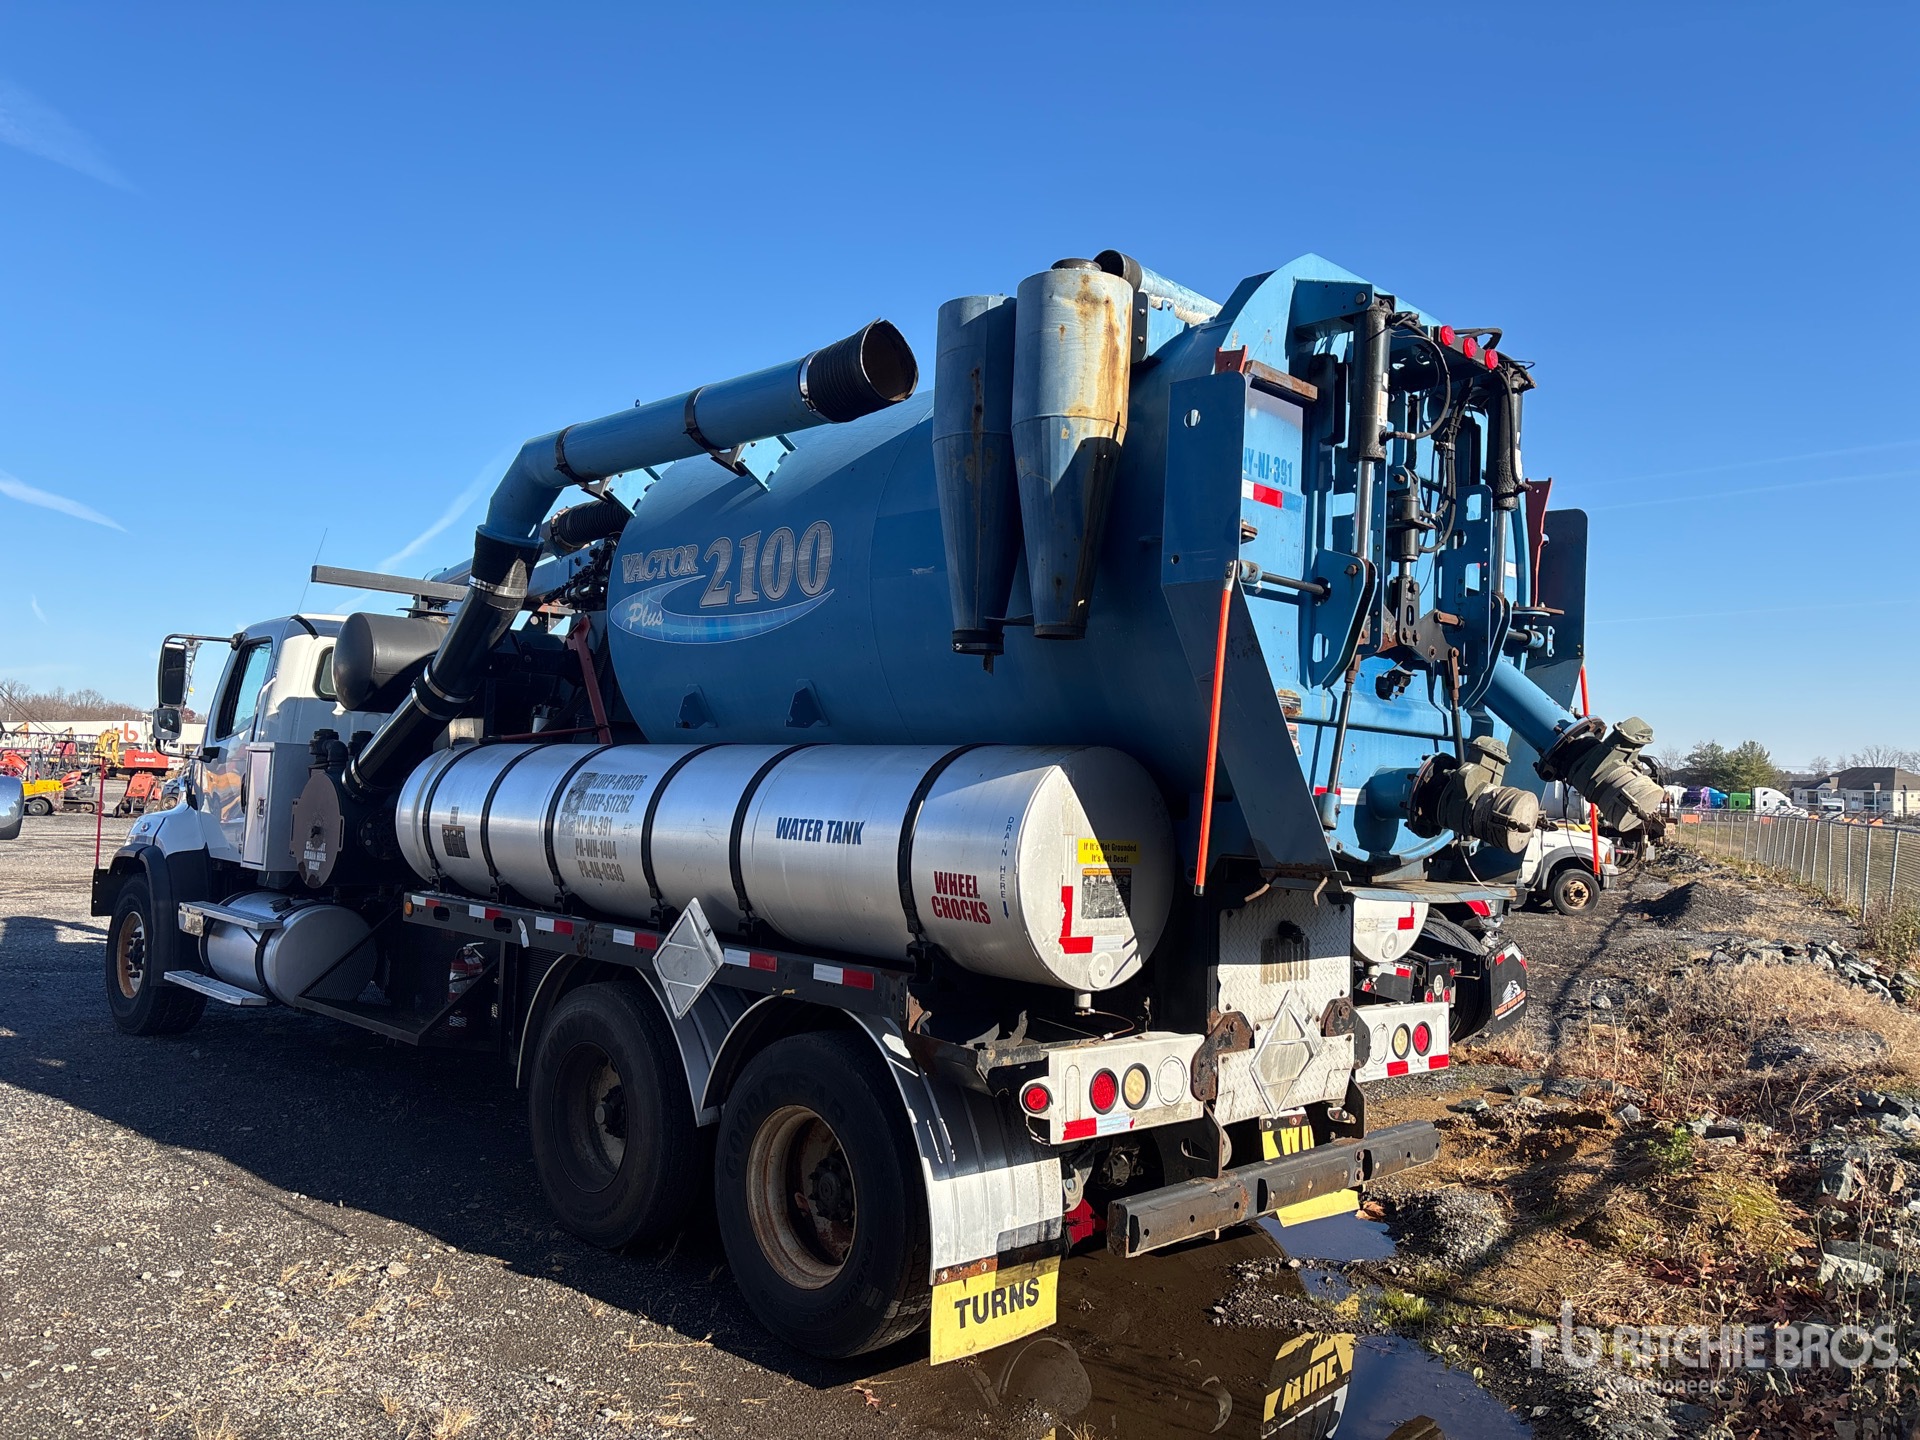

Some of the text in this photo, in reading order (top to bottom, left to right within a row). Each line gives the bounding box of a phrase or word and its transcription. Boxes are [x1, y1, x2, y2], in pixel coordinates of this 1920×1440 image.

[621, 519, 834, 609] VACTOR 2100
[622, 602, 665, 630] Plus
[776, 816, 865, 845] WATER TANK
[1001, 816, 1015, 857] DRAIN
[1089, 843, 1099, 851] It's
[1100, 843, 1110, 851] Not
[1111, 844, 1137, 852] Grounded
[1091, 854, 1101, 863] It's
[1113, 855, 1129, 863] Dead!
[933, 870, 980, 899] WHEEL
[931, 895, 991, 925] CHOCKS
[954, 1278, 1040, 1330] TURNS
